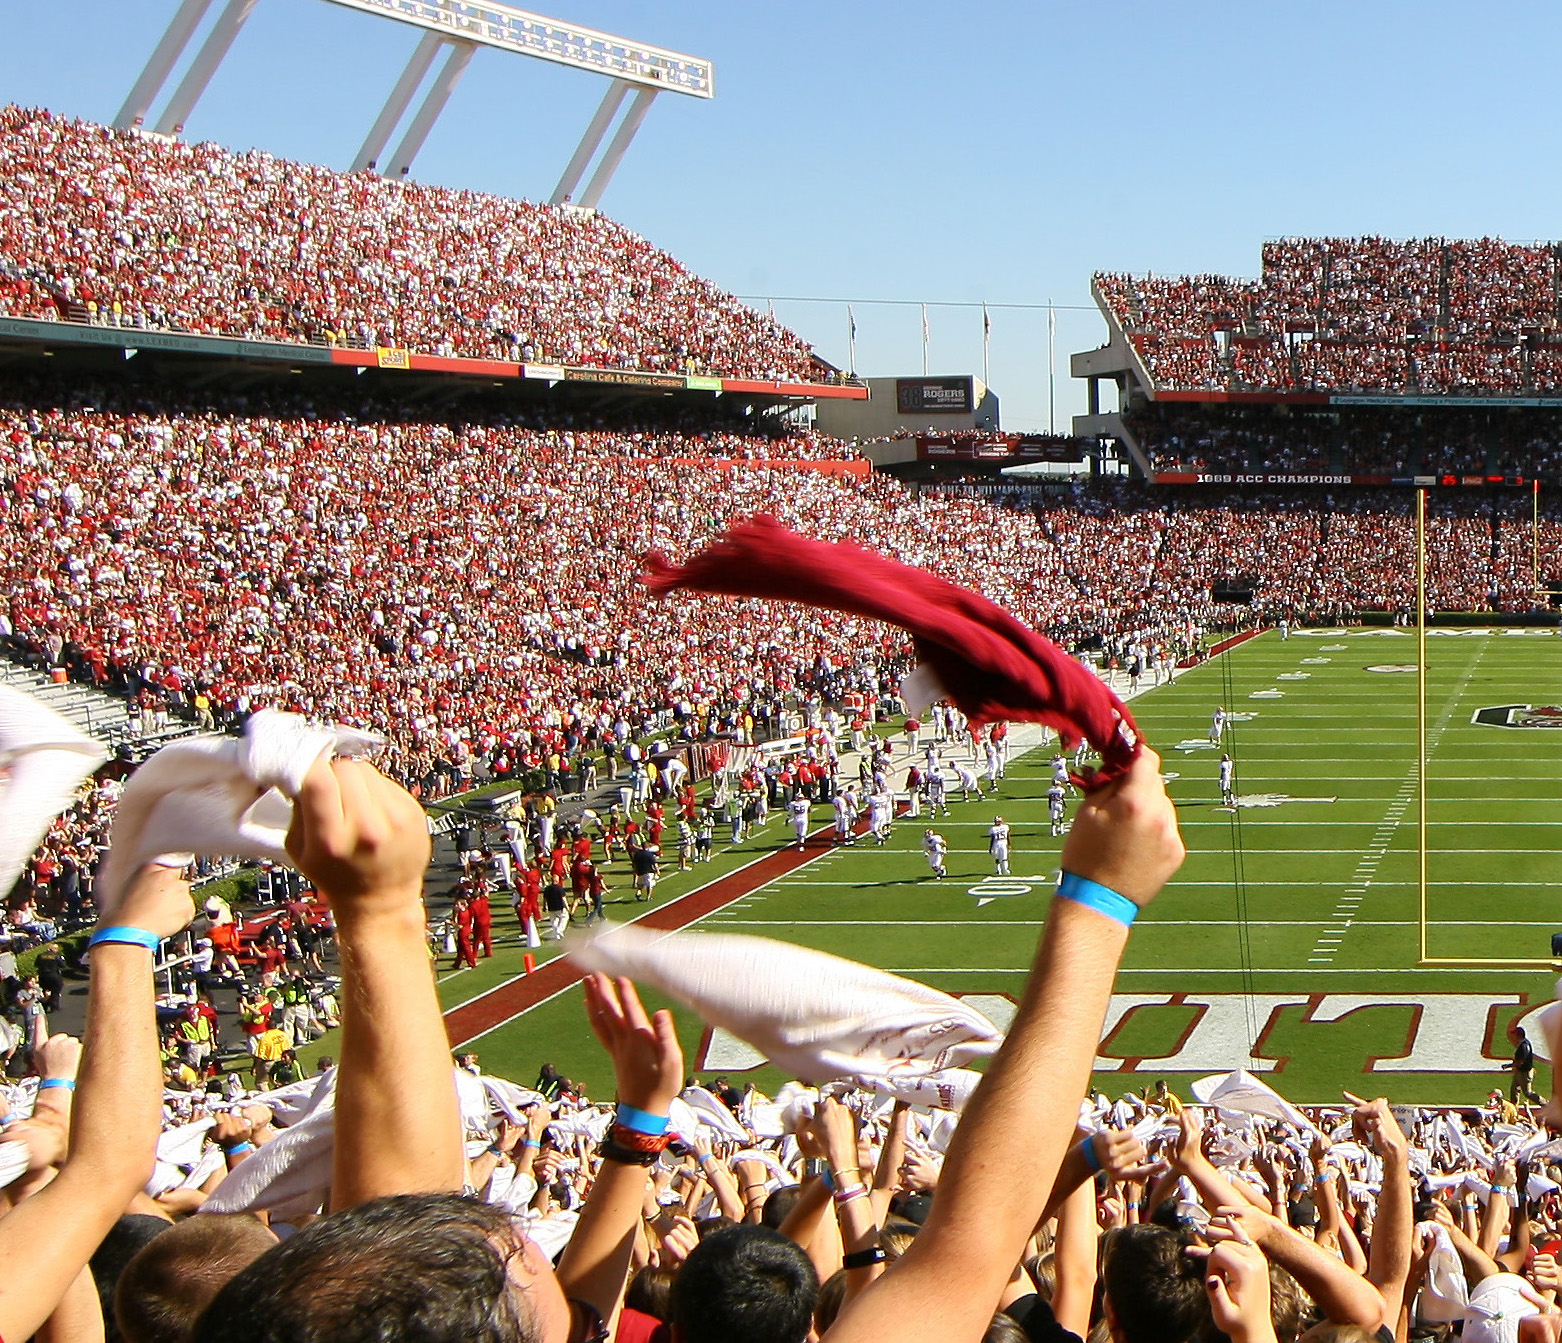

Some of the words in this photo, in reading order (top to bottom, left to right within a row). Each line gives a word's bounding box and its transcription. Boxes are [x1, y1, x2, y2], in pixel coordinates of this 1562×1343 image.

[923, 389, 965, 398] ROGERS
[1236, 474, 1264, 484] ACC
[1268, 474, 1352, 485] CHAMPIONS
